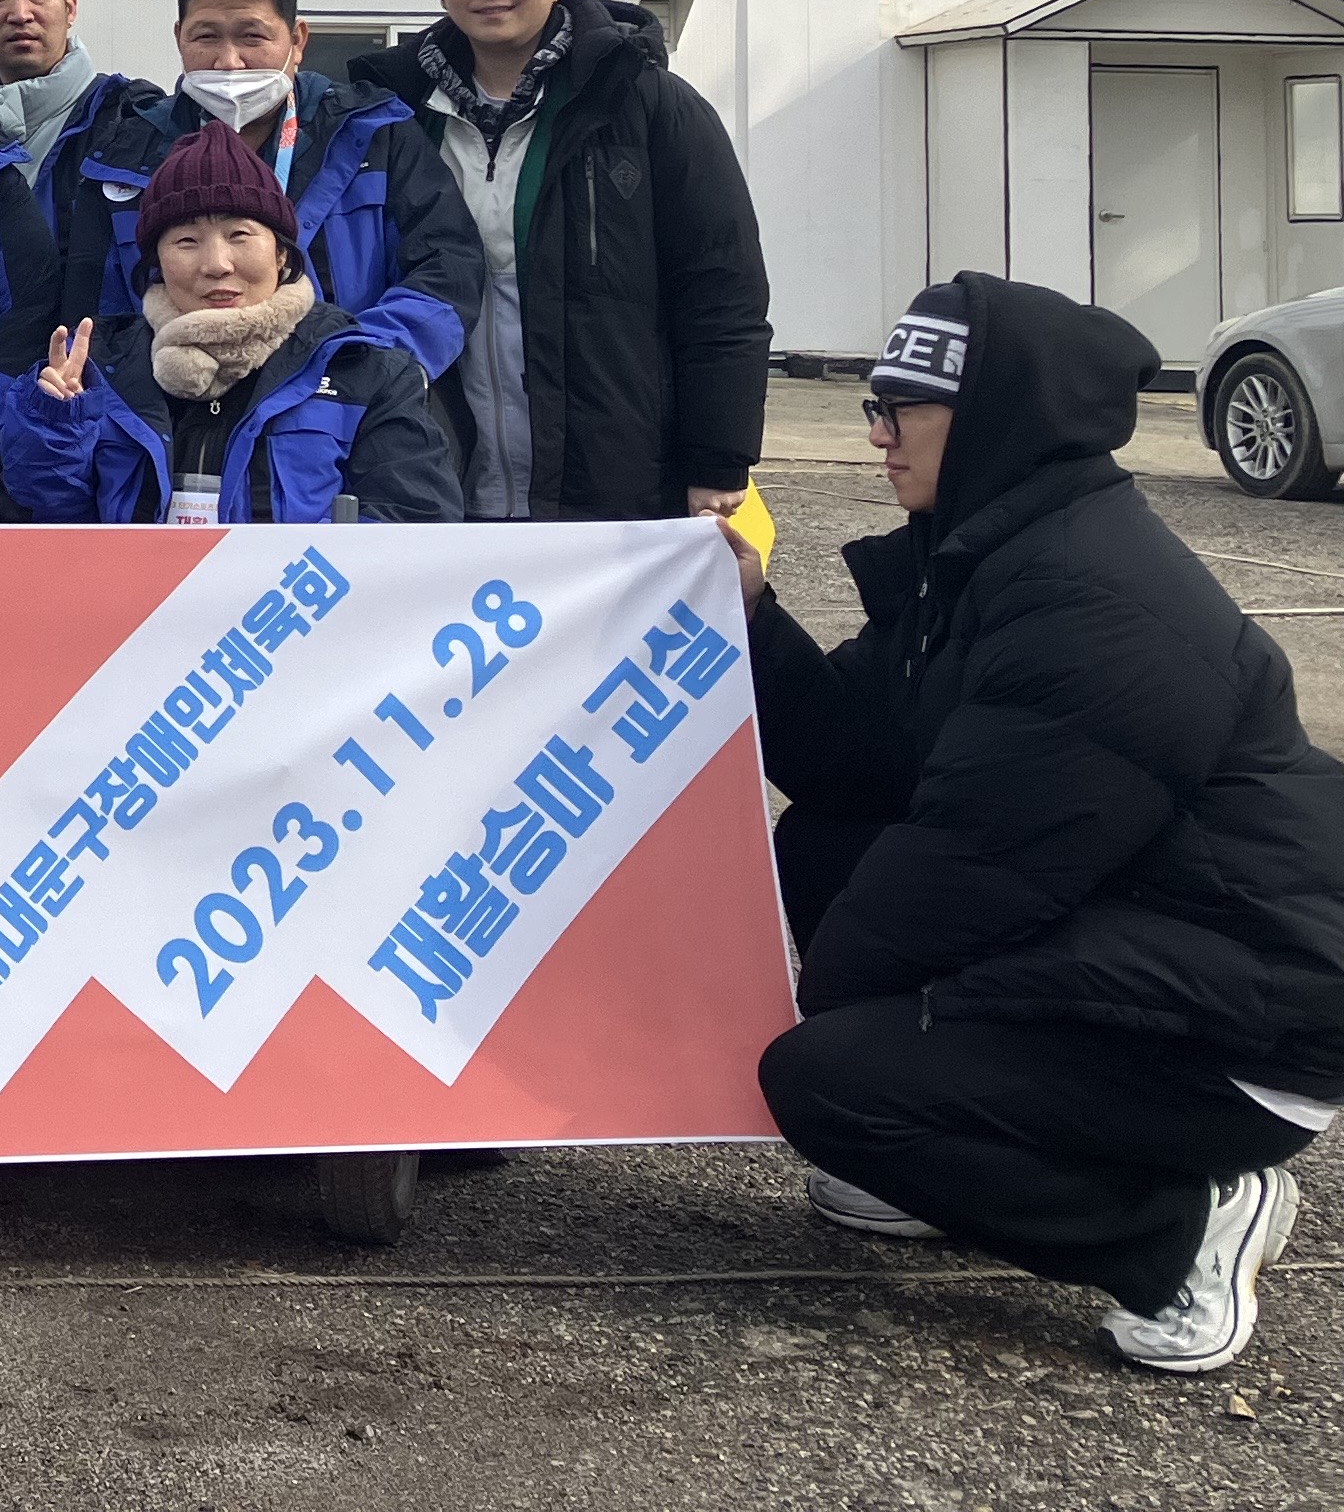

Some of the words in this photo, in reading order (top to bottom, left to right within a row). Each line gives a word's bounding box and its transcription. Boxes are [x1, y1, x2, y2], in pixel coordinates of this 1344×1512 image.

[155, 578, 544, 1018] 2023.11.28
[367, 734, 616, 1024] 재활승마
[582, 598, 742, 765] 교실
